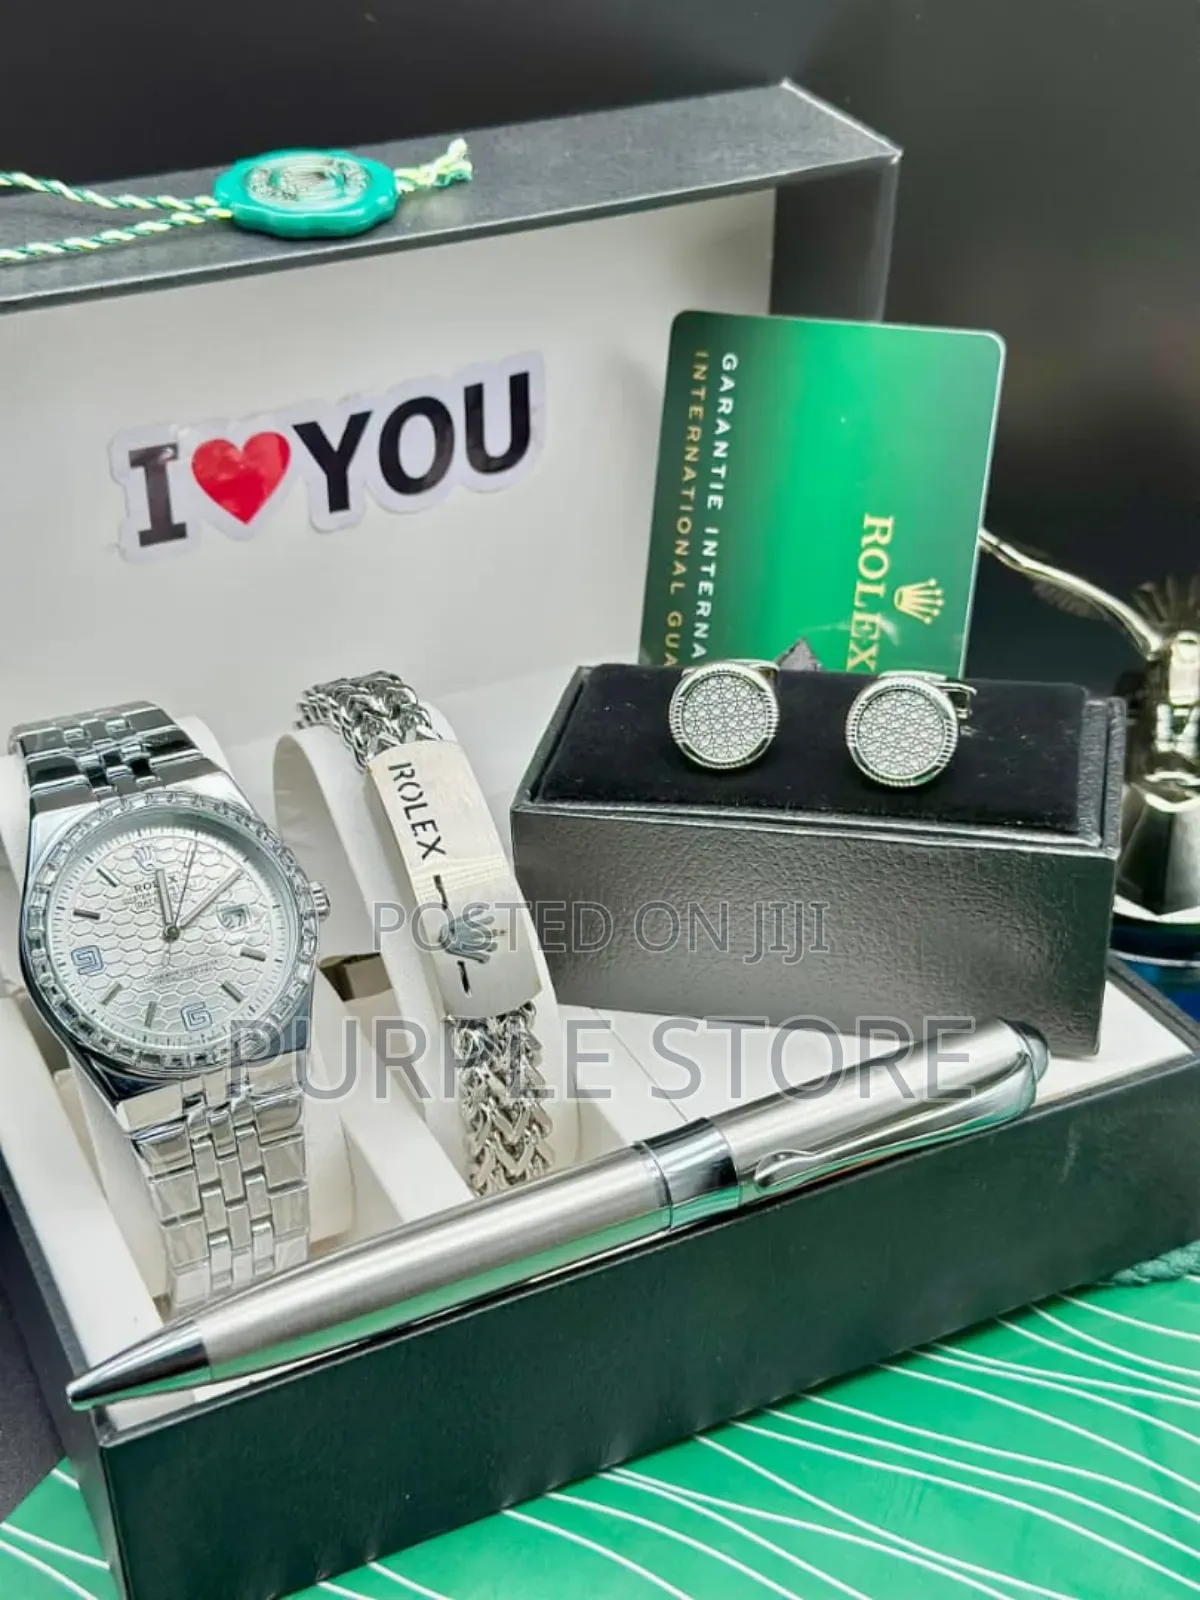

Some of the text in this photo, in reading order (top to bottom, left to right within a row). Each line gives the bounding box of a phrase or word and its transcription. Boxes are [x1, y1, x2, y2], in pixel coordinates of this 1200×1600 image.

[128, 371, 531, 547] I YOU
[670, 351, 709, 595] INTERNATIONAL
[691, 352, 738, 660] GARANTIE INTERNA
[846, 513, 895, 672] ROLEX
[132, 873, 179, 893] ROLX
[388, 762, 446, 861] ROLEX
